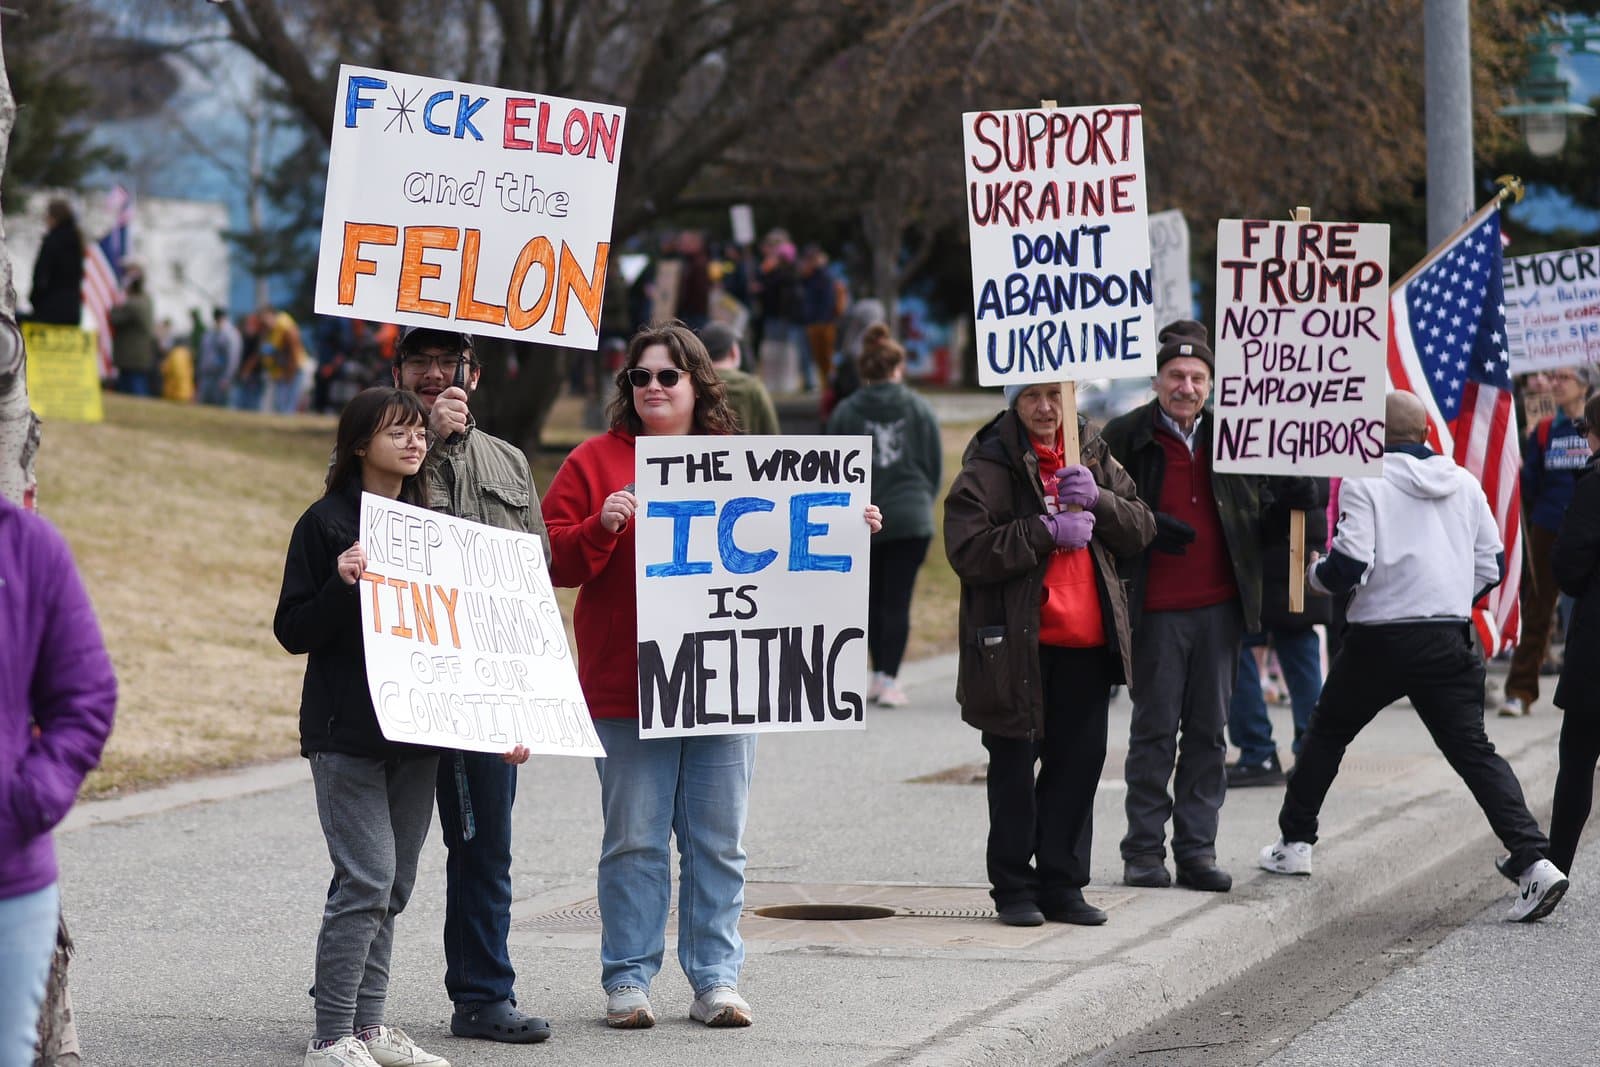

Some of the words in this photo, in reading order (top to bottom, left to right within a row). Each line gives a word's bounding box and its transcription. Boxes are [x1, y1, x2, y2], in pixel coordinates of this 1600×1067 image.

[503, 96, 620, 163] ELON
[971, 108, 1142, 174] SUPPORT
[403, 170, 485, 208] and
[495, 172, 570, 217] the
[970, 173, 1137, 228] UKRAINE
[1012, 223, 1111, 270] DON'T
[1241, 219, 1360, 261] FIRE
[337, 220, 611, 336] FELON
[976, 268, 1153, 320] ABANDON
[1220, 257, 1384, 306] TRUMP
[1503, 251, 1600, 289] EMOCR
[987, 314, 1142, 375] UKRAINE
[1221, 305, 1296, 340] NOT
[1301, 306, 1381, 342] OUR
[1241, 338, 1352, 375] PUBLIC
[1219, 376, 1366, 408] EMPLOYEE
[1216, 417, 1385, 464] NEIGHBORS
[646, 450, 733, 485] THE
[745, 449, 866, 484] WRONG
[366, 505, 443, 576] KEEP
[450, 524, 551, 598] YOUR
[645, 491, 853, 578] ICE
[360, 570, 462, 650] TINY
[464, 591, 568, 661] HANDS
[707, 584, 759, 620] IS
[410, 651, 463, 685] OFF
[474, 657, 535, 692] OUR
[638, 624, 865, 730] MELTING
[379, 680, 600, 749] CONSTITUTION
